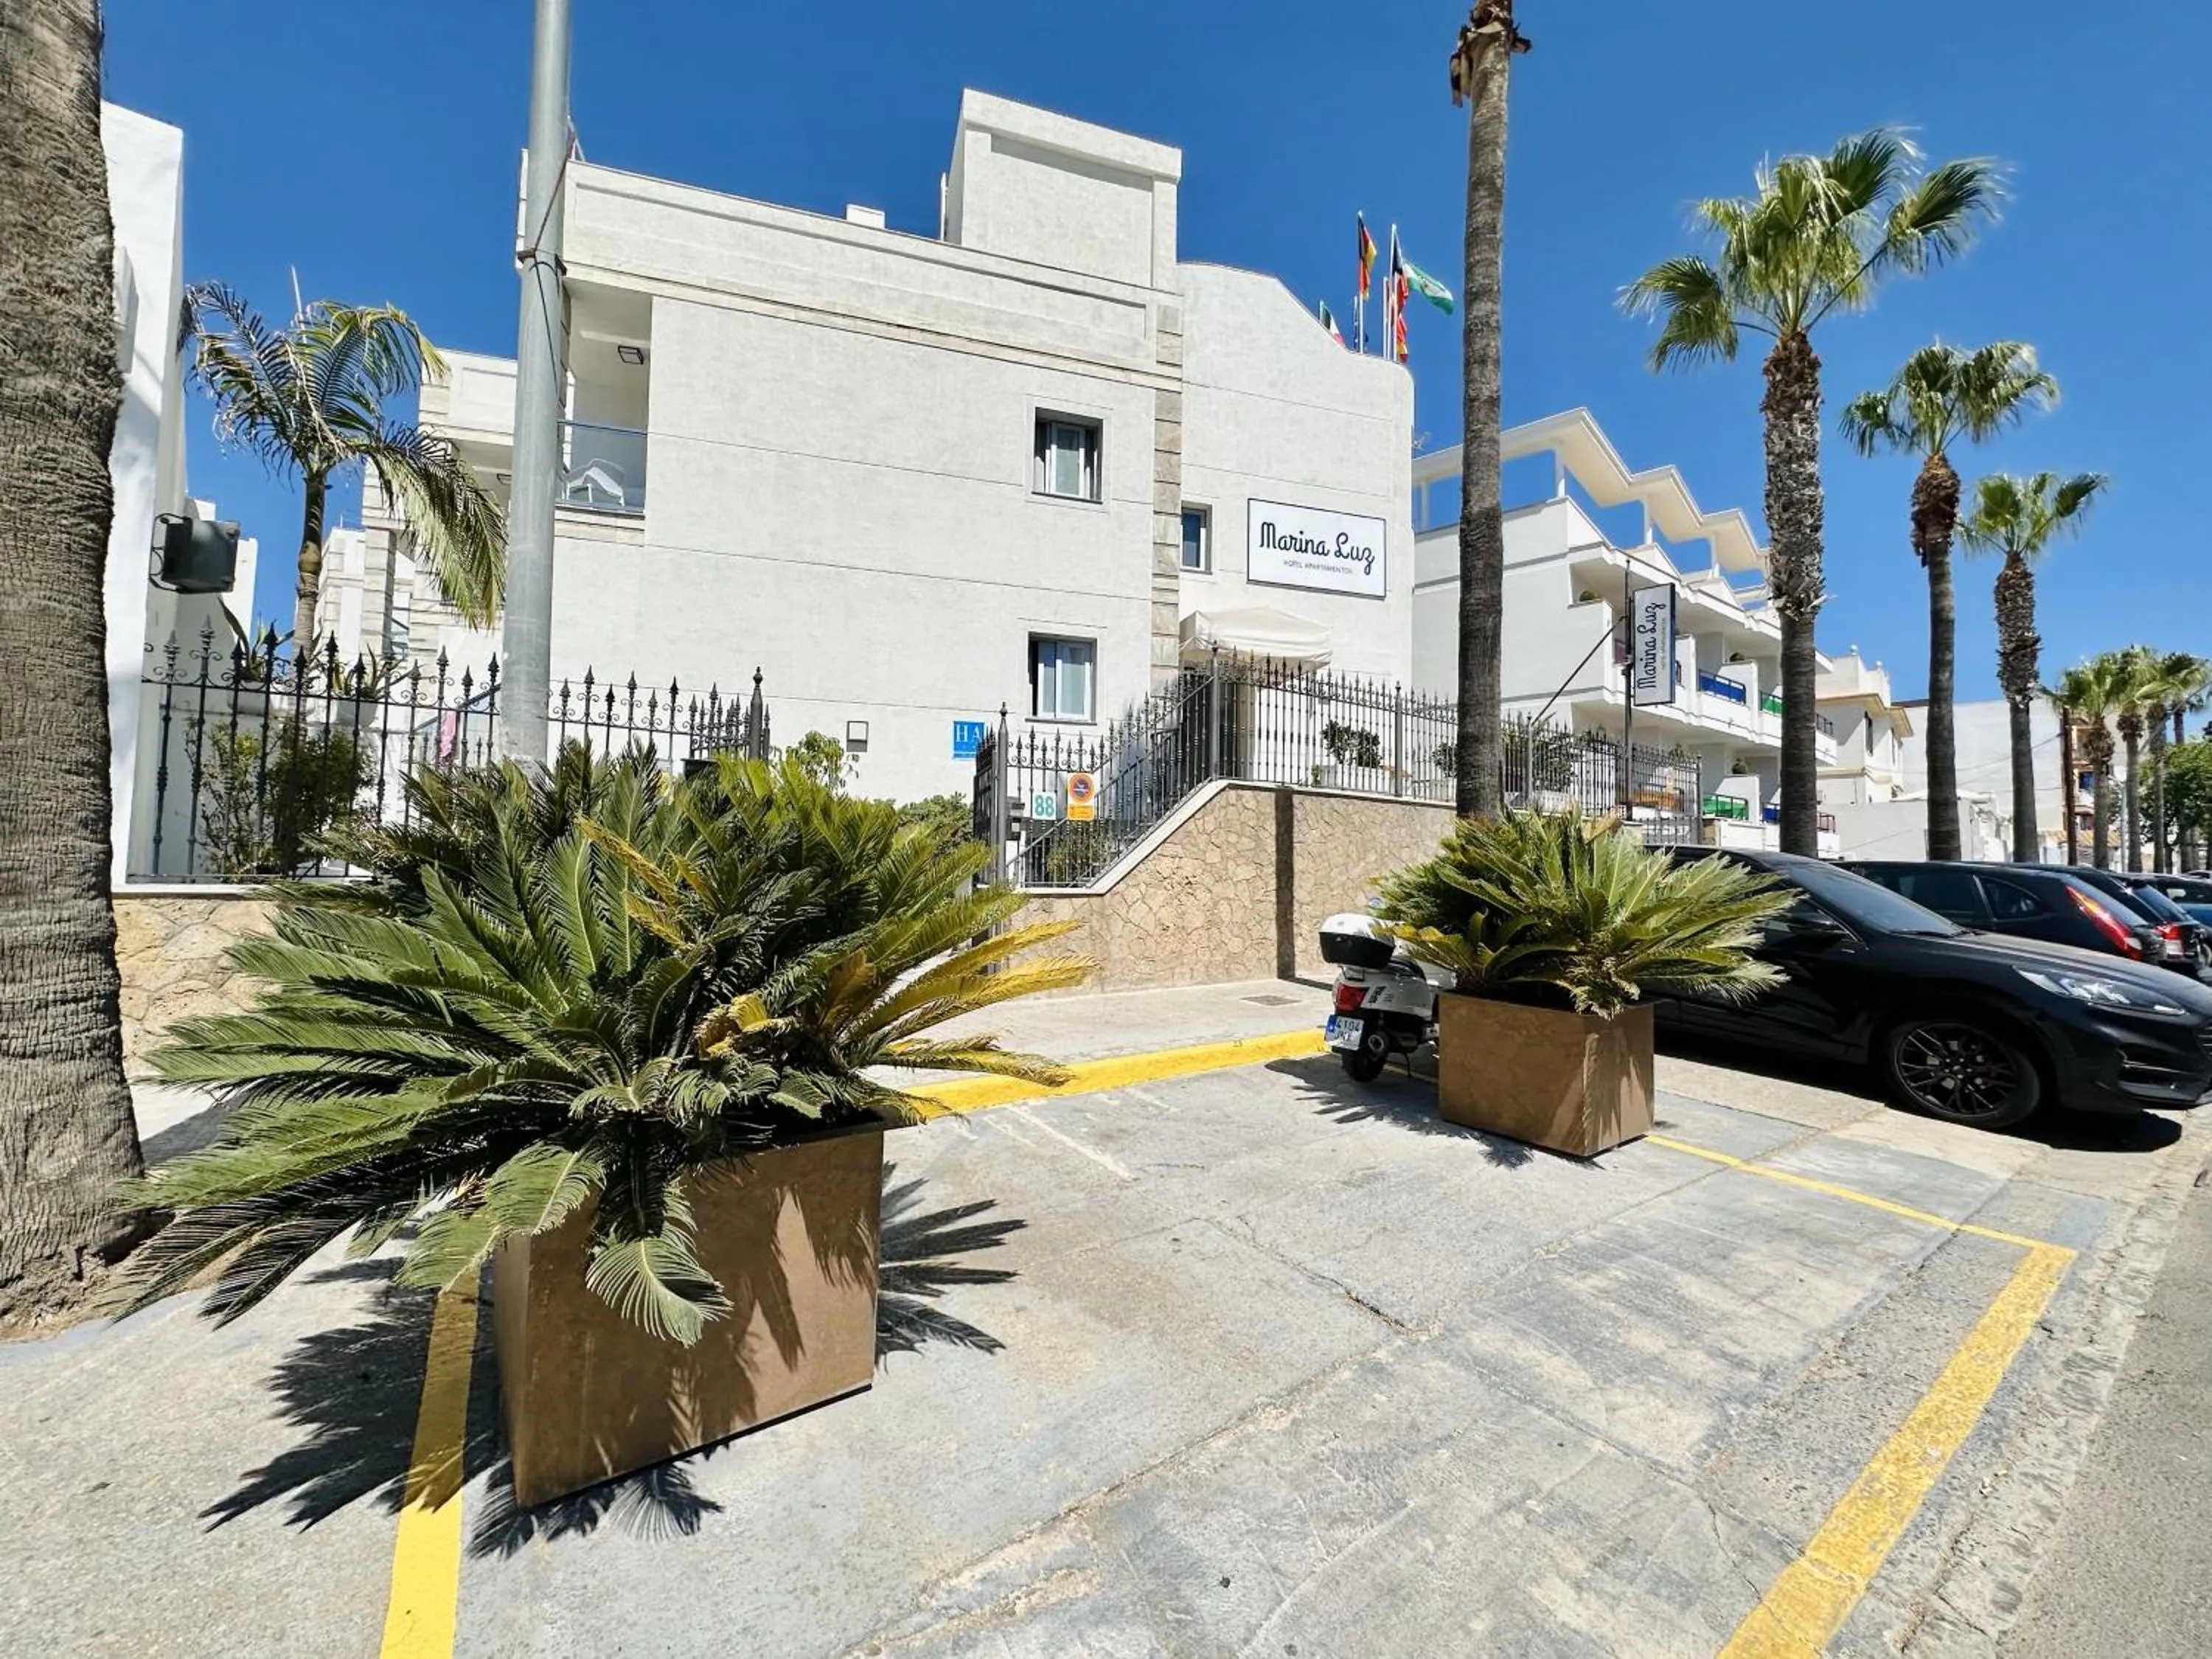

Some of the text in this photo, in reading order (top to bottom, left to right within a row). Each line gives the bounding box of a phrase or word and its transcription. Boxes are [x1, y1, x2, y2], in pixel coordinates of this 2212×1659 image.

[1259, 521, 1375, 576] Marina Luz
[1636, 602, 1667, 689] Marina Luz
[1034, 794, 1055, 818] 88
